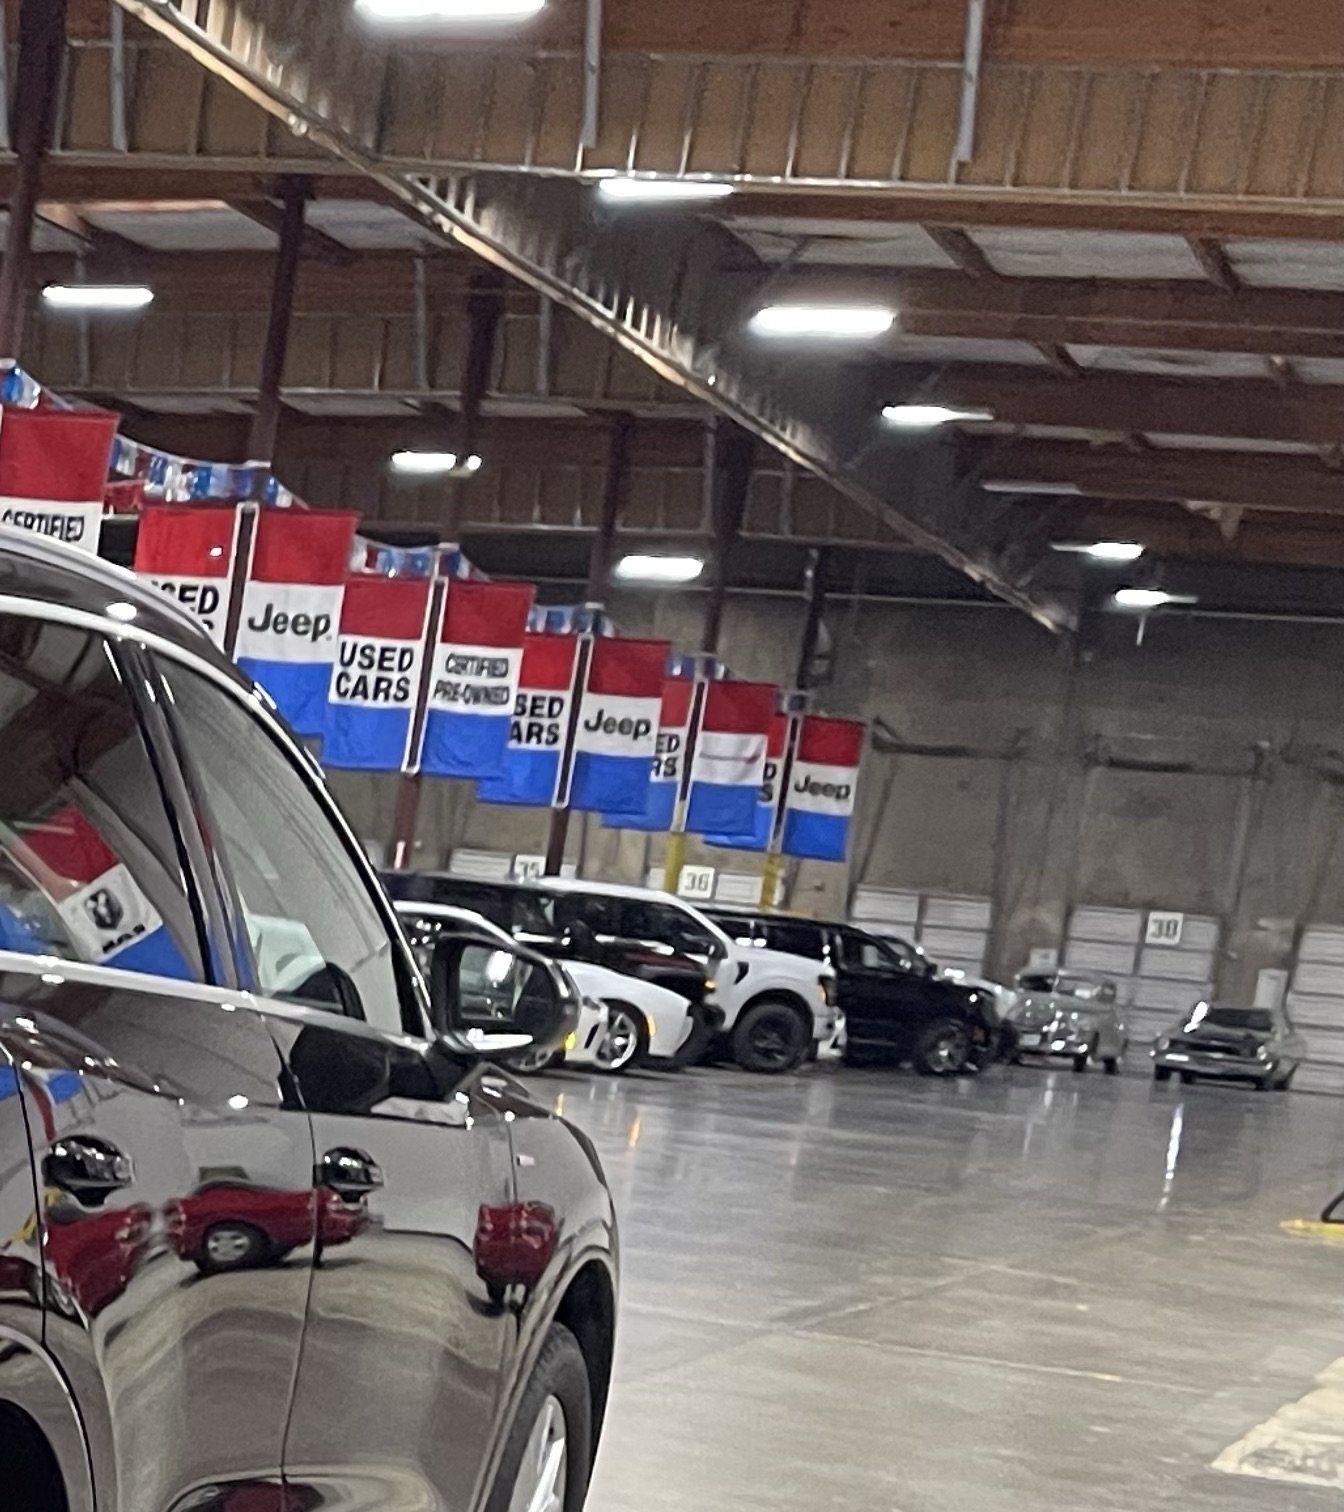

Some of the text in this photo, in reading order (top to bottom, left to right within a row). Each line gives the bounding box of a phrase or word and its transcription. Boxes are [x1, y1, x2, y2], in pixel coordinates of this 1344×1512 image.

[247, 603, 331, 643] Jeep
[339, 642, 414, 672] USED
[335, 672, 411, 702] CARS
[514, 693, 564, 719] SED
[509, 720, 560, 745] ARS
[583, 709, 652, 741] Jeep
